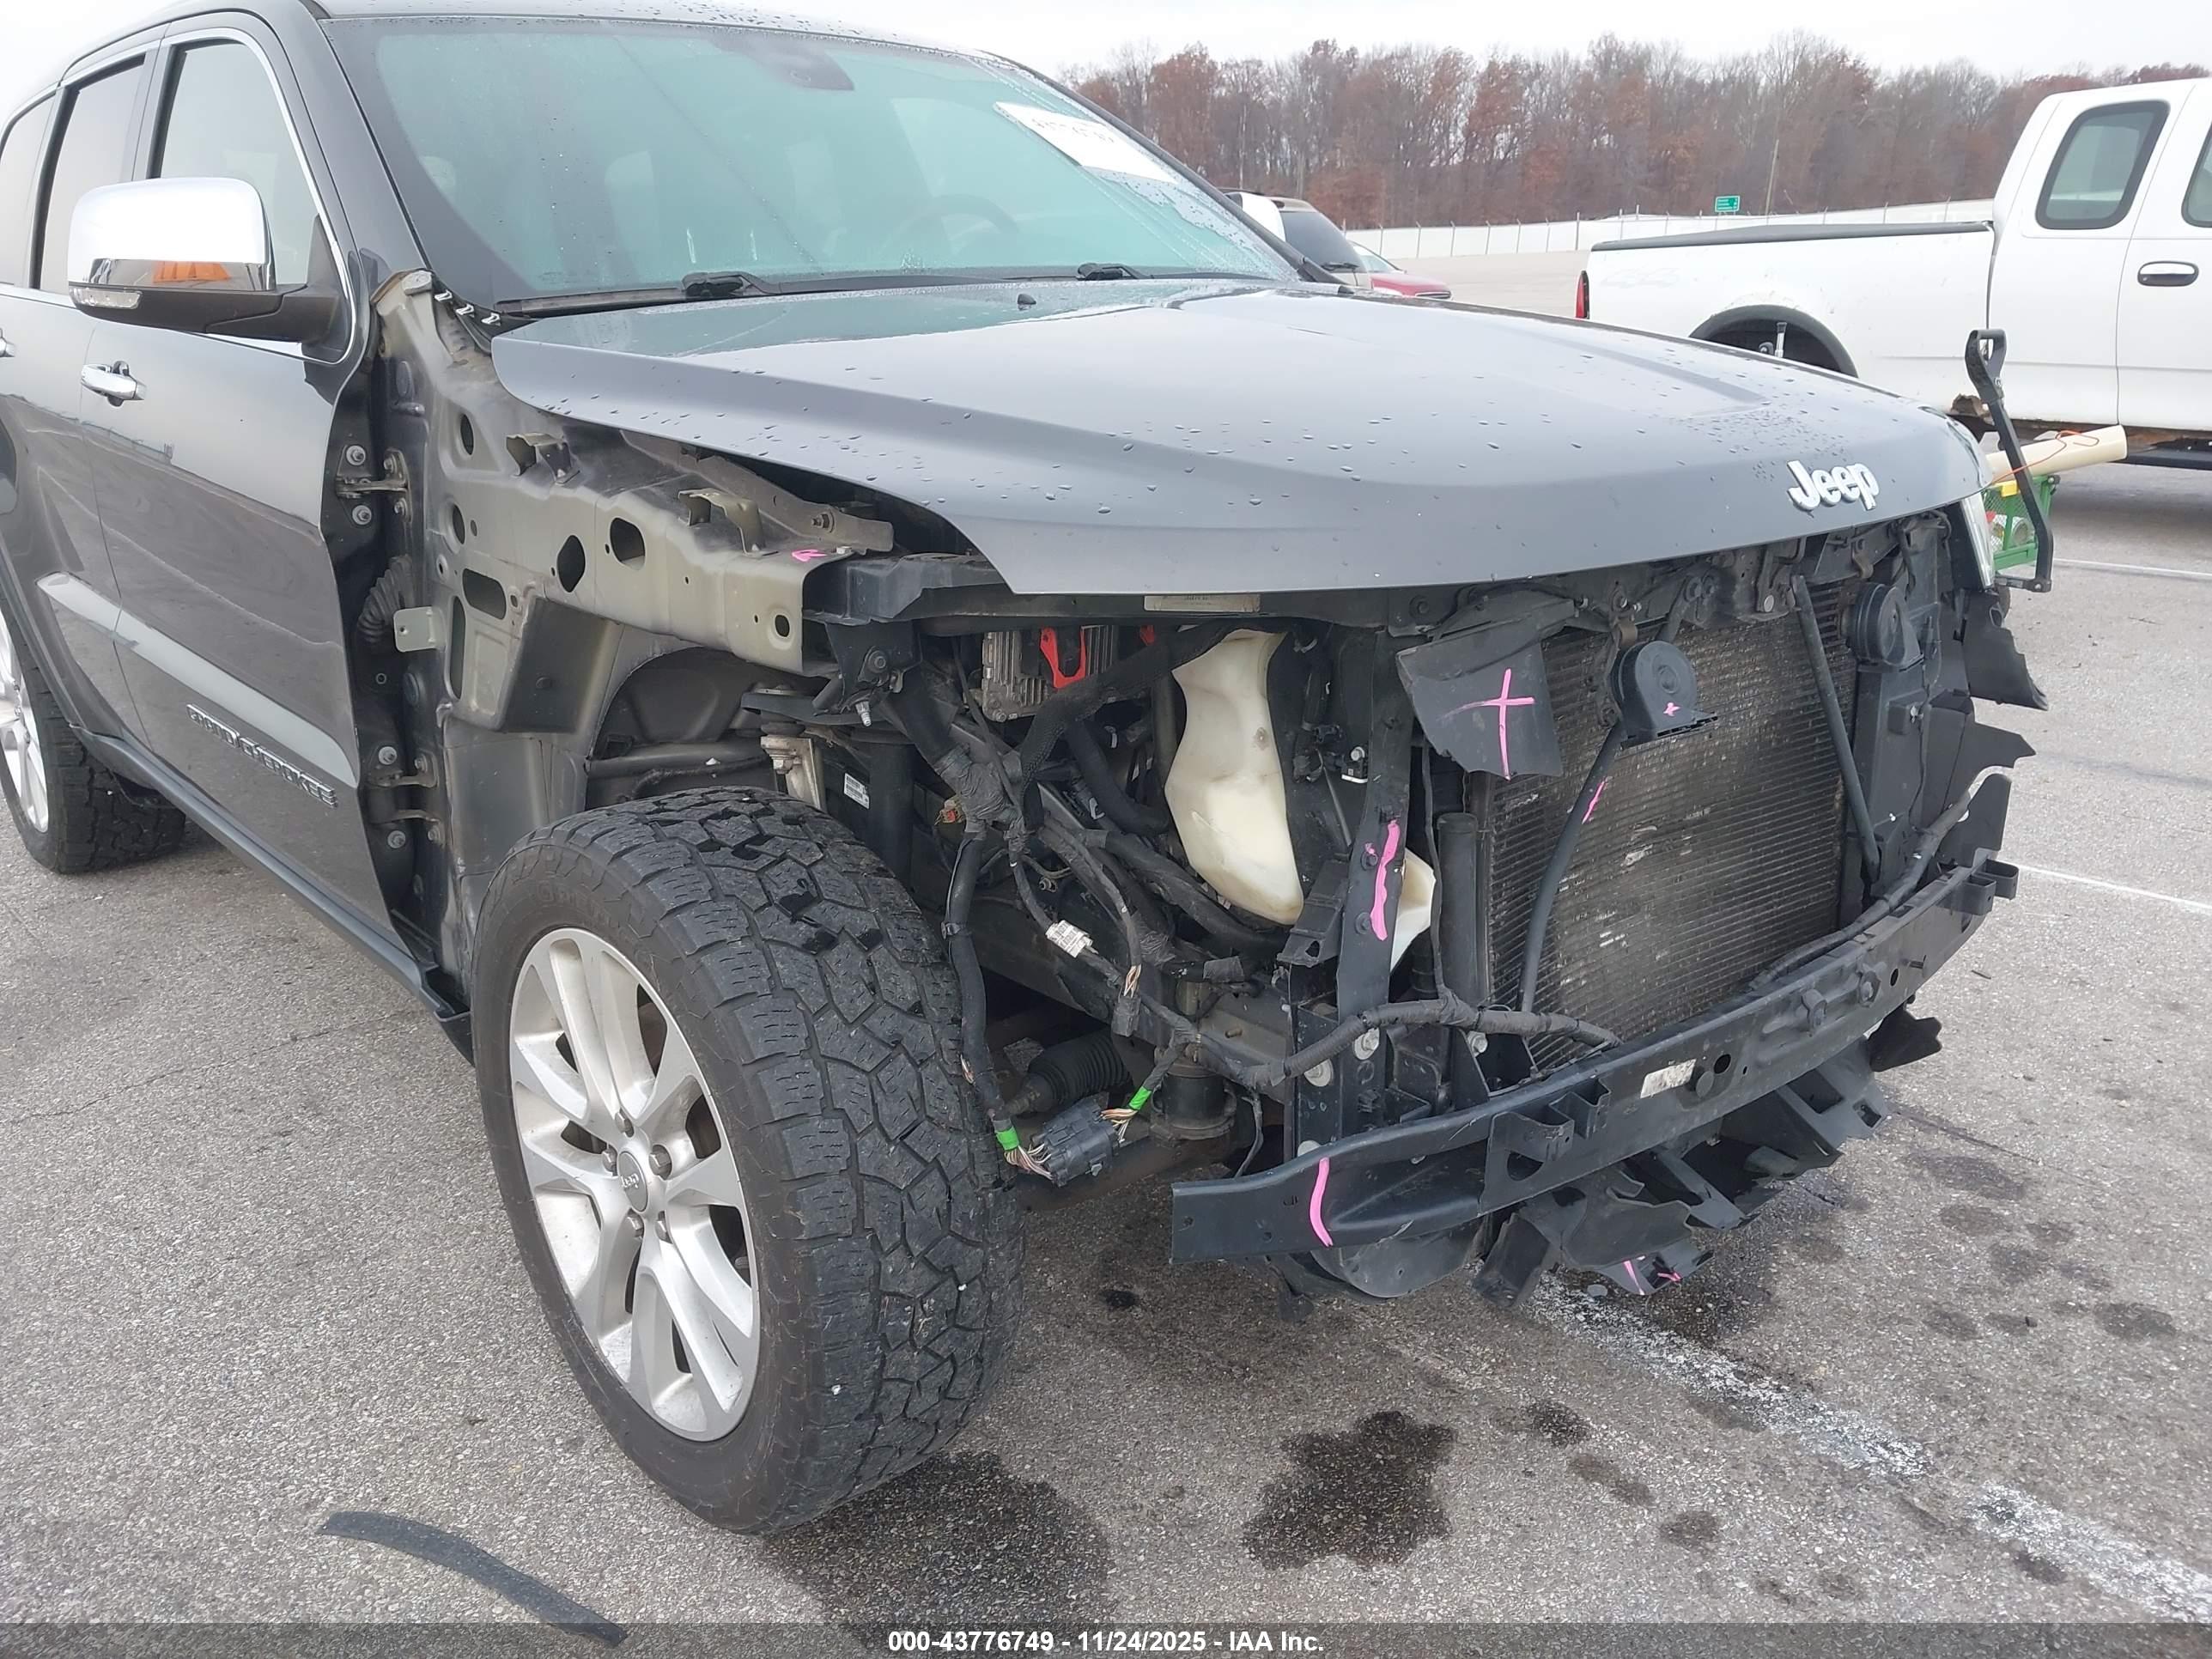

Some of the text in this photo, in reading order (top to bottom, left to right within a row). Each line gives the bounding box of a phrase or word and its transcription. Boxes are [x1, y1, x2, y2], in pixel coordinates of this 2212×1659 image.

[1787, 460, 1879, 510] Jeep
[186, 704, 338, 808] GRAND CHEROKEE
